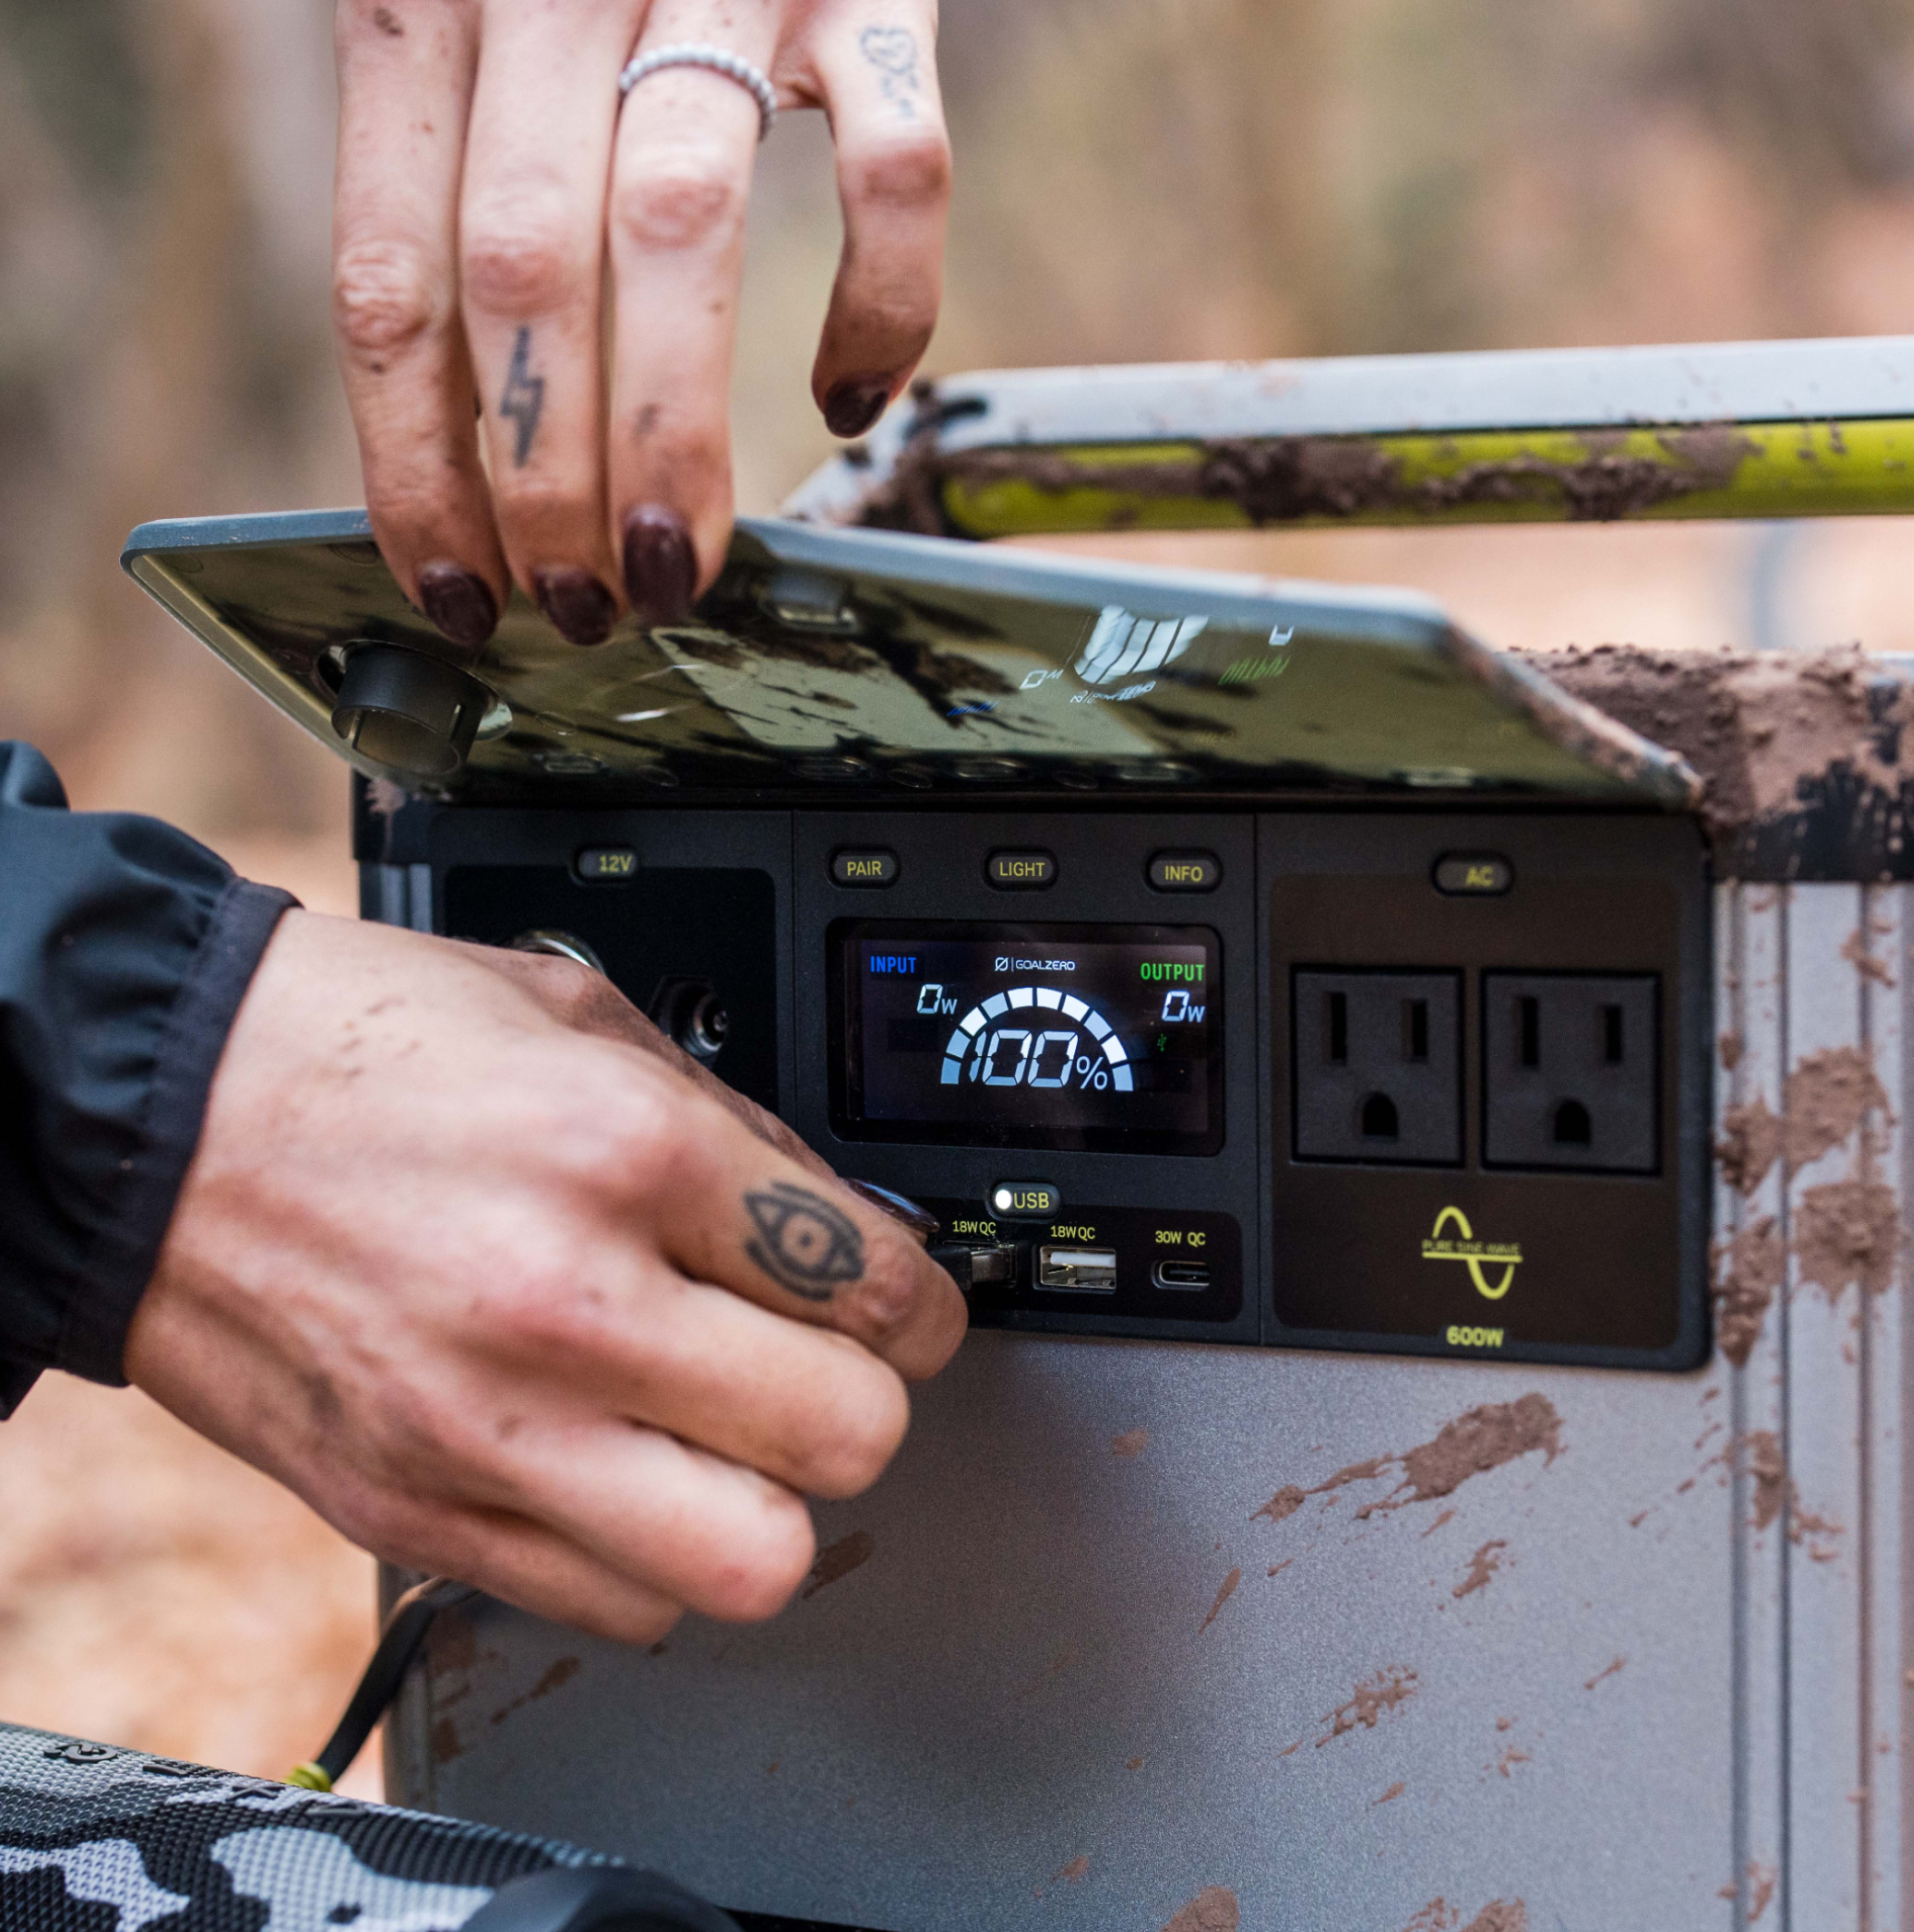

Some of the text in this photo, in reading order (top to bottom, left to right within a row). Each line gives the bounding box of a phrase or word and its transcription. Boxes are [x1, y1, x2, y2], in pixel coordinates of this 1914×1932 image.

[600, 855, 632, 872] 12V
[847, 861, 882, 876] PAIR
[1000, 861, 1045, 877] LIGHT
[1165, 866, 1203, 882] INFO
[1465, 865, 1493, 886] AC
[870, 955, 917, 974] INPUT
[1015, 960, 1076, 971] GOALZERO
[1140, 963, 1205, 981] OUTPUT
[969, 1030, 1108, 1090] 100%
[1013, 1192, 1050, 1210] USB
[1154, 1230, 1206, 1248] 30W QC
[1445, 1325, 1504, 1348] 600W
